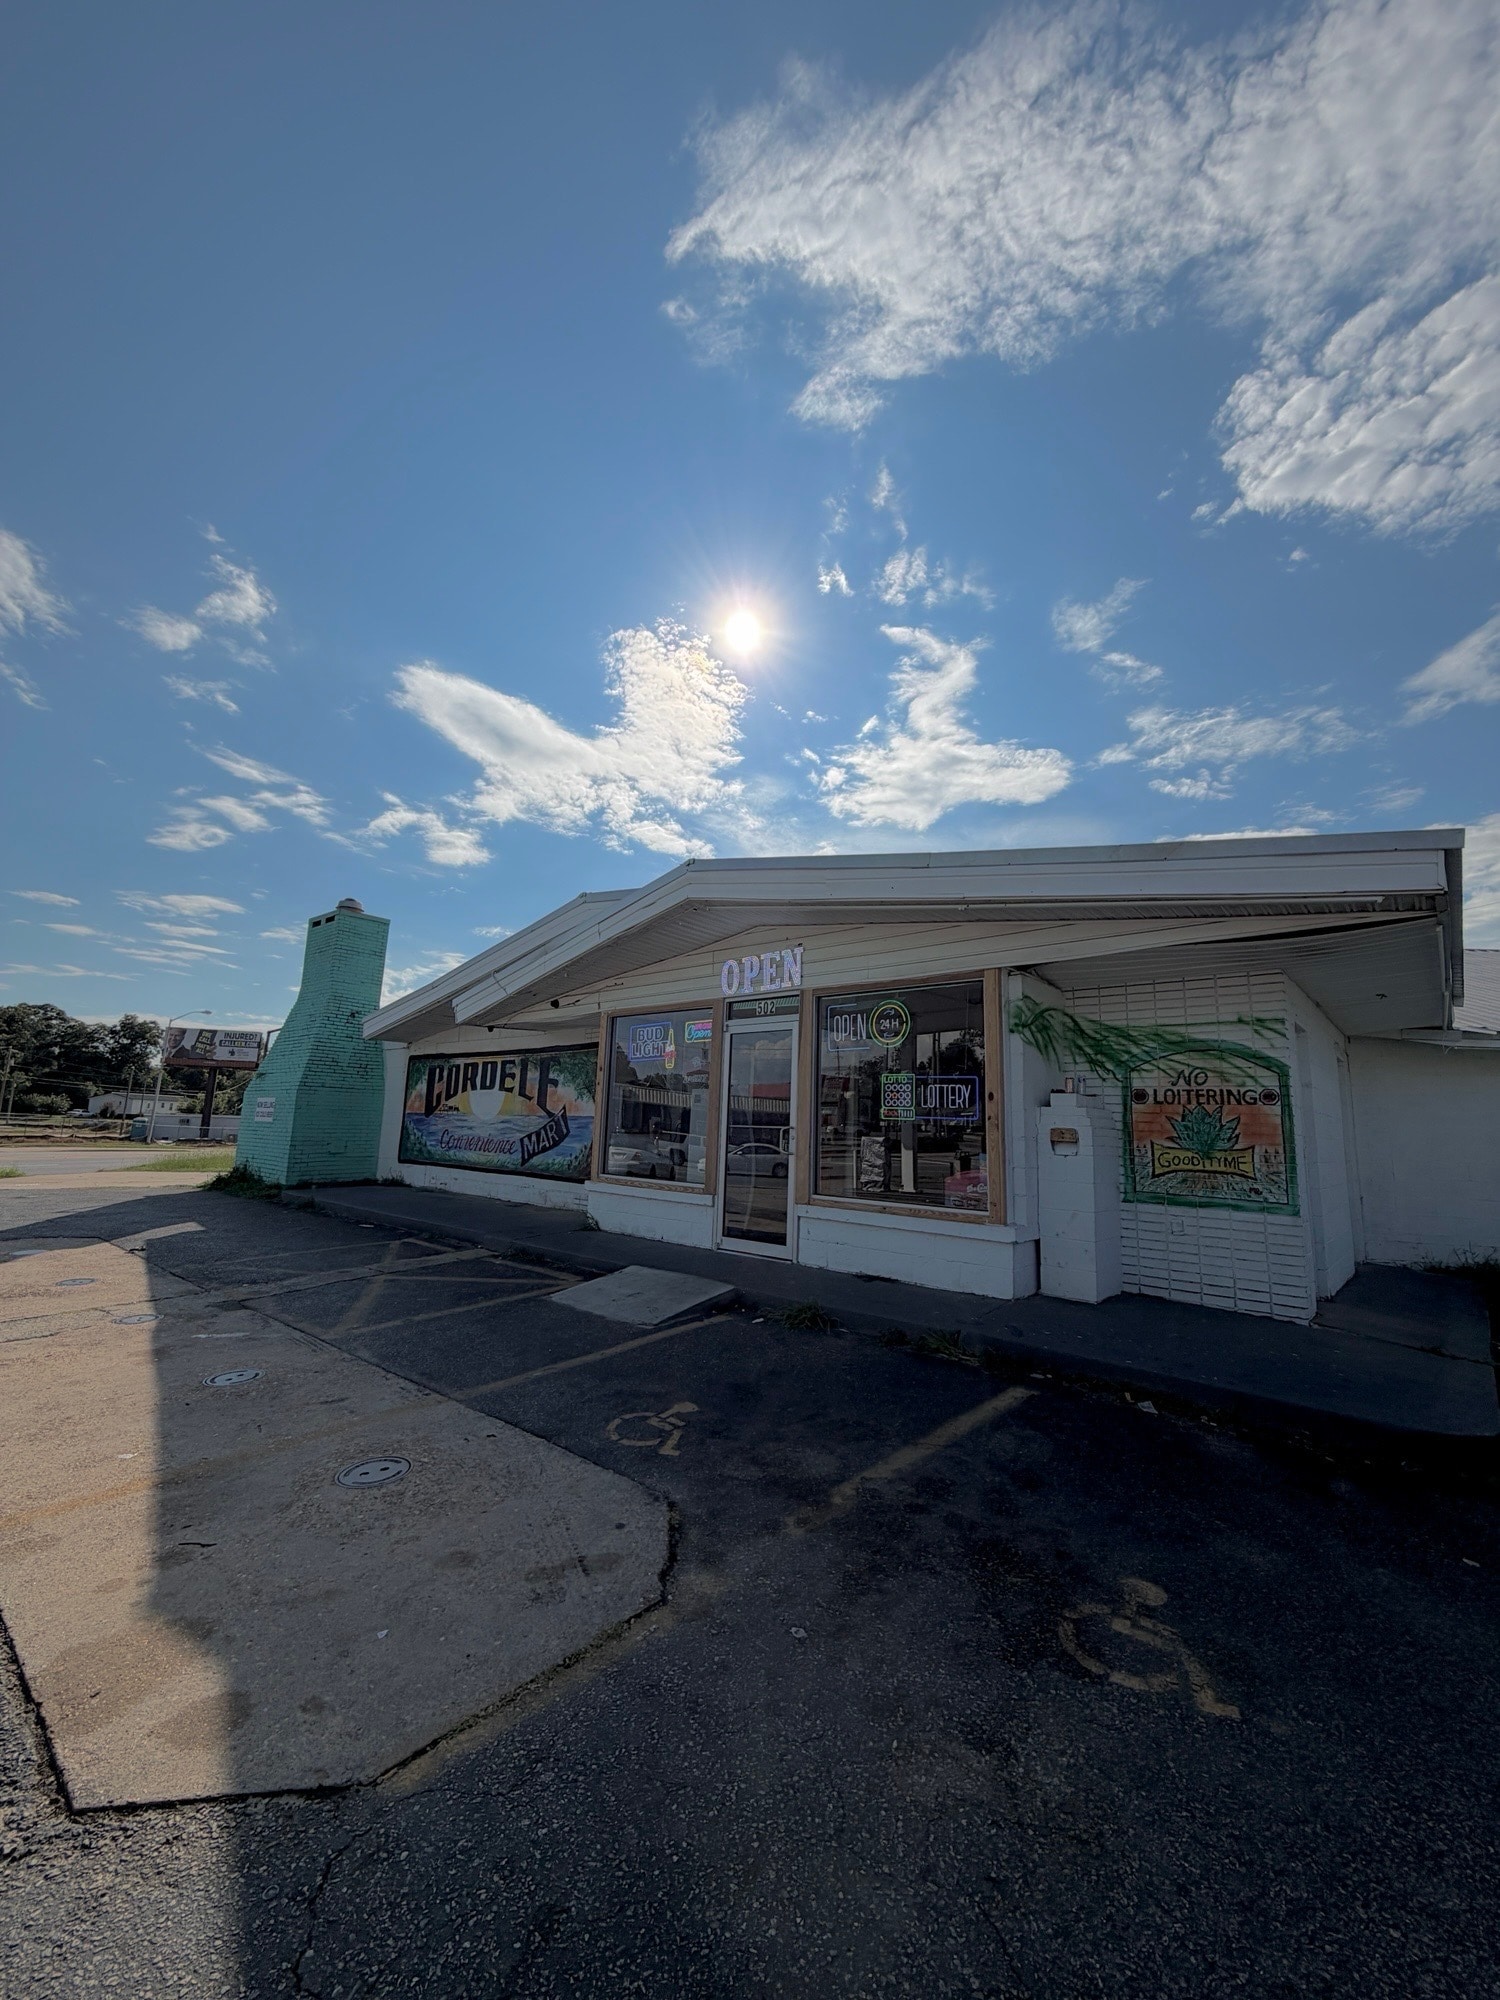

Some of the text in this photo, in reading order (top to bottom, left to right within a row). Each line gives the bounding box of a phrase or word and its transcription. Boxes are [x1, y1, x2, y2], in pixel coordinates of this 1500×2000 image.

[720, 947, 804, 996] OPEN
[757, 1001, 776, 1016] 502
[224, 1032, 258, 1041] INJURED?
[636, 1025, 664, 1043] BUD
[833, 1013, 867, 1042] OPEN
[632, 1041, 668, 1058] LIGHT
[883, 1075, 909, 1084] LOTTO
[1169, 1068, 1209, 1087] NO
[920, 1083, 971, 1109] LOTTERY
[1152, 1088, 1258, 1106] LOITERING
[440, 1110, 569, 1159] Convenience MART
[1157, 1151, 1201, 1169] GOOD
